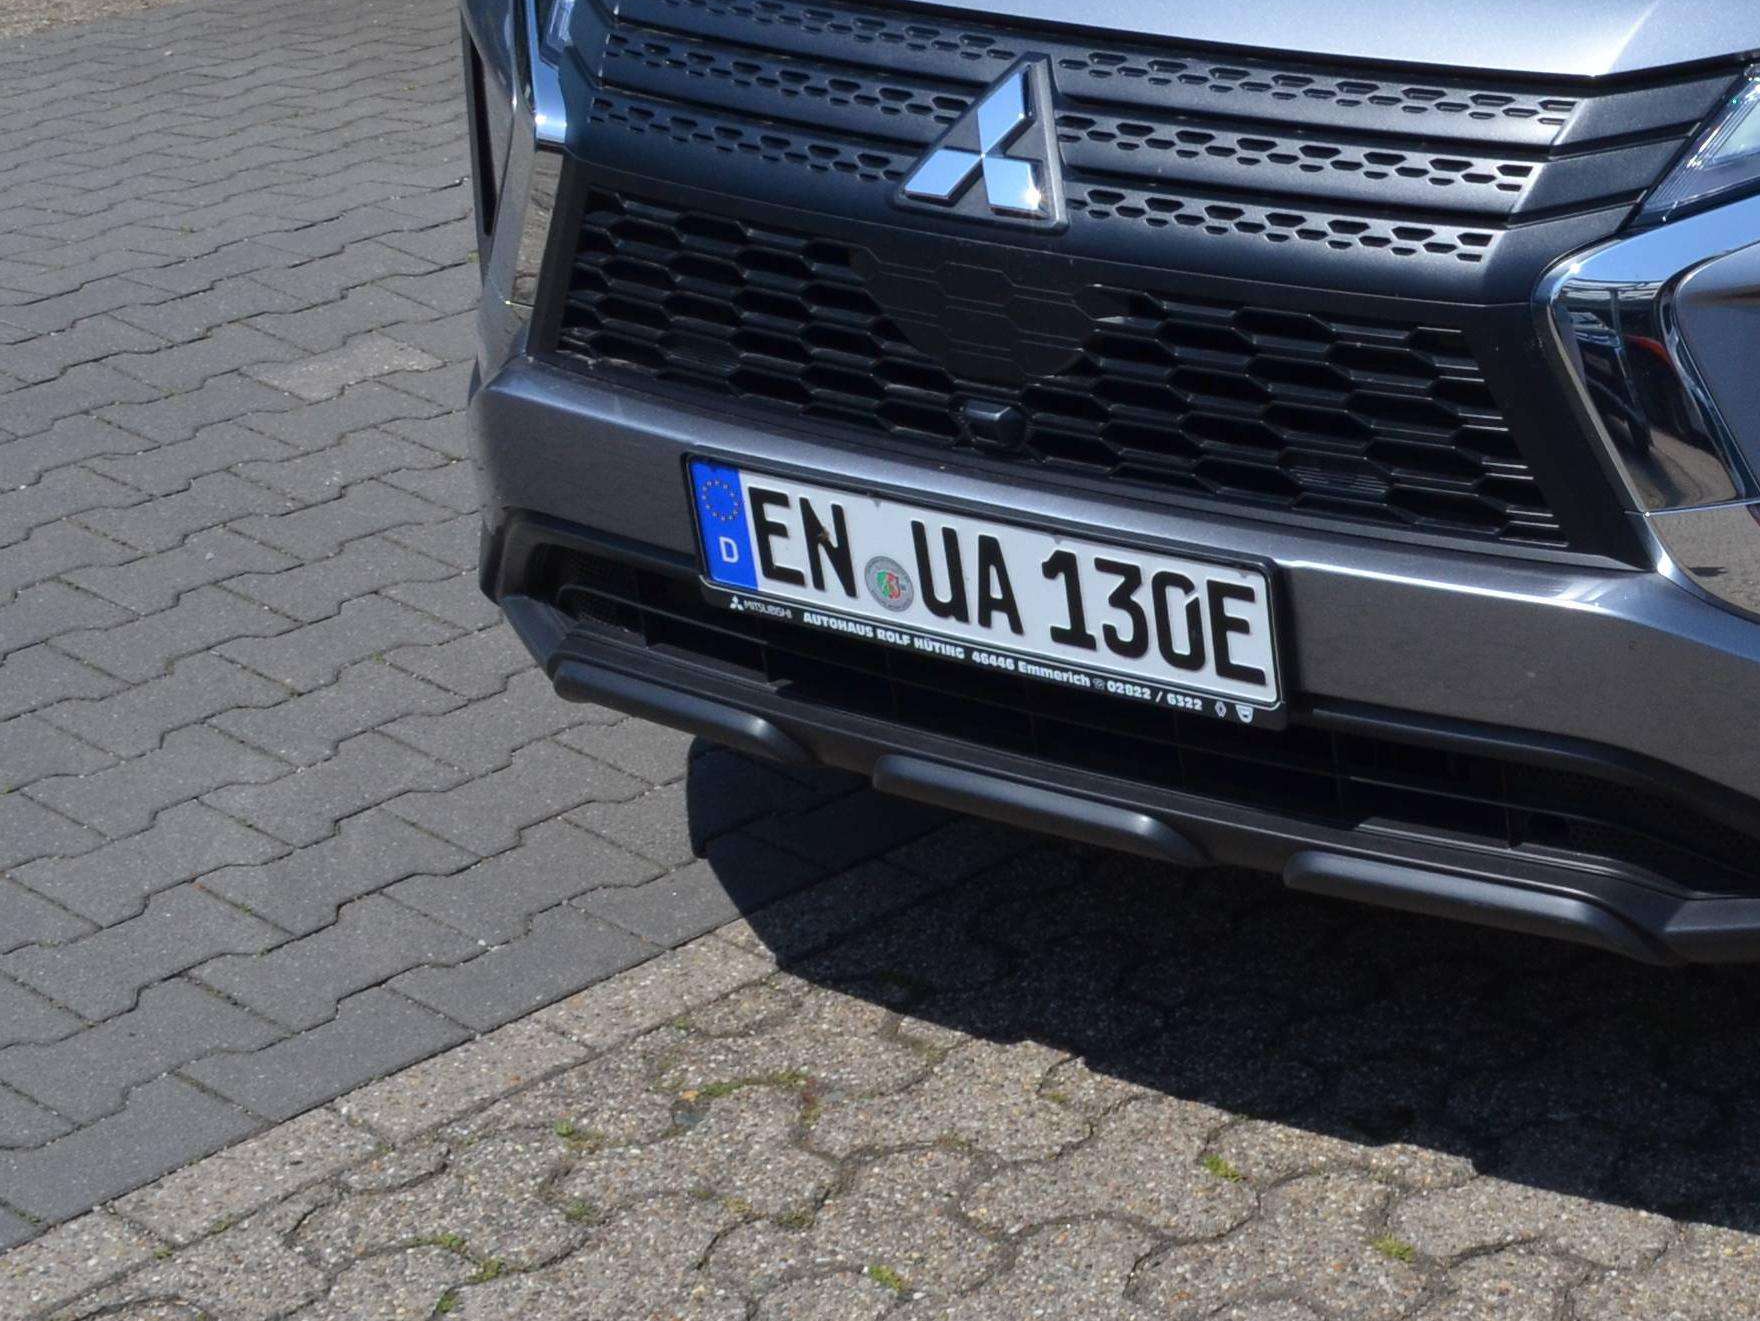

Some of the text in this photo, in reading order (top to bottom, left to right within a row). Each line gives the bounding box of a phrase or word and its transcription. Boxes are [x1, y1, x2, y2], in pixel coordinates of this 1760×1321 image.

[719, 537, 739, 564] D
[744, 599, 793, 619] MITSUBISHI
[747, 485, 1267, 687] EN UA 130E
[803, 612, 874, 638] AUTOHAUS
[876, 628, 911, 646] ROLF
[971, 650, 1015, 671] 46446
[1018, 661, 1091, 687] Emmerich
[1106, 680, 1152, 700] 02822
[1166, 692, 1204, 711] 6322
